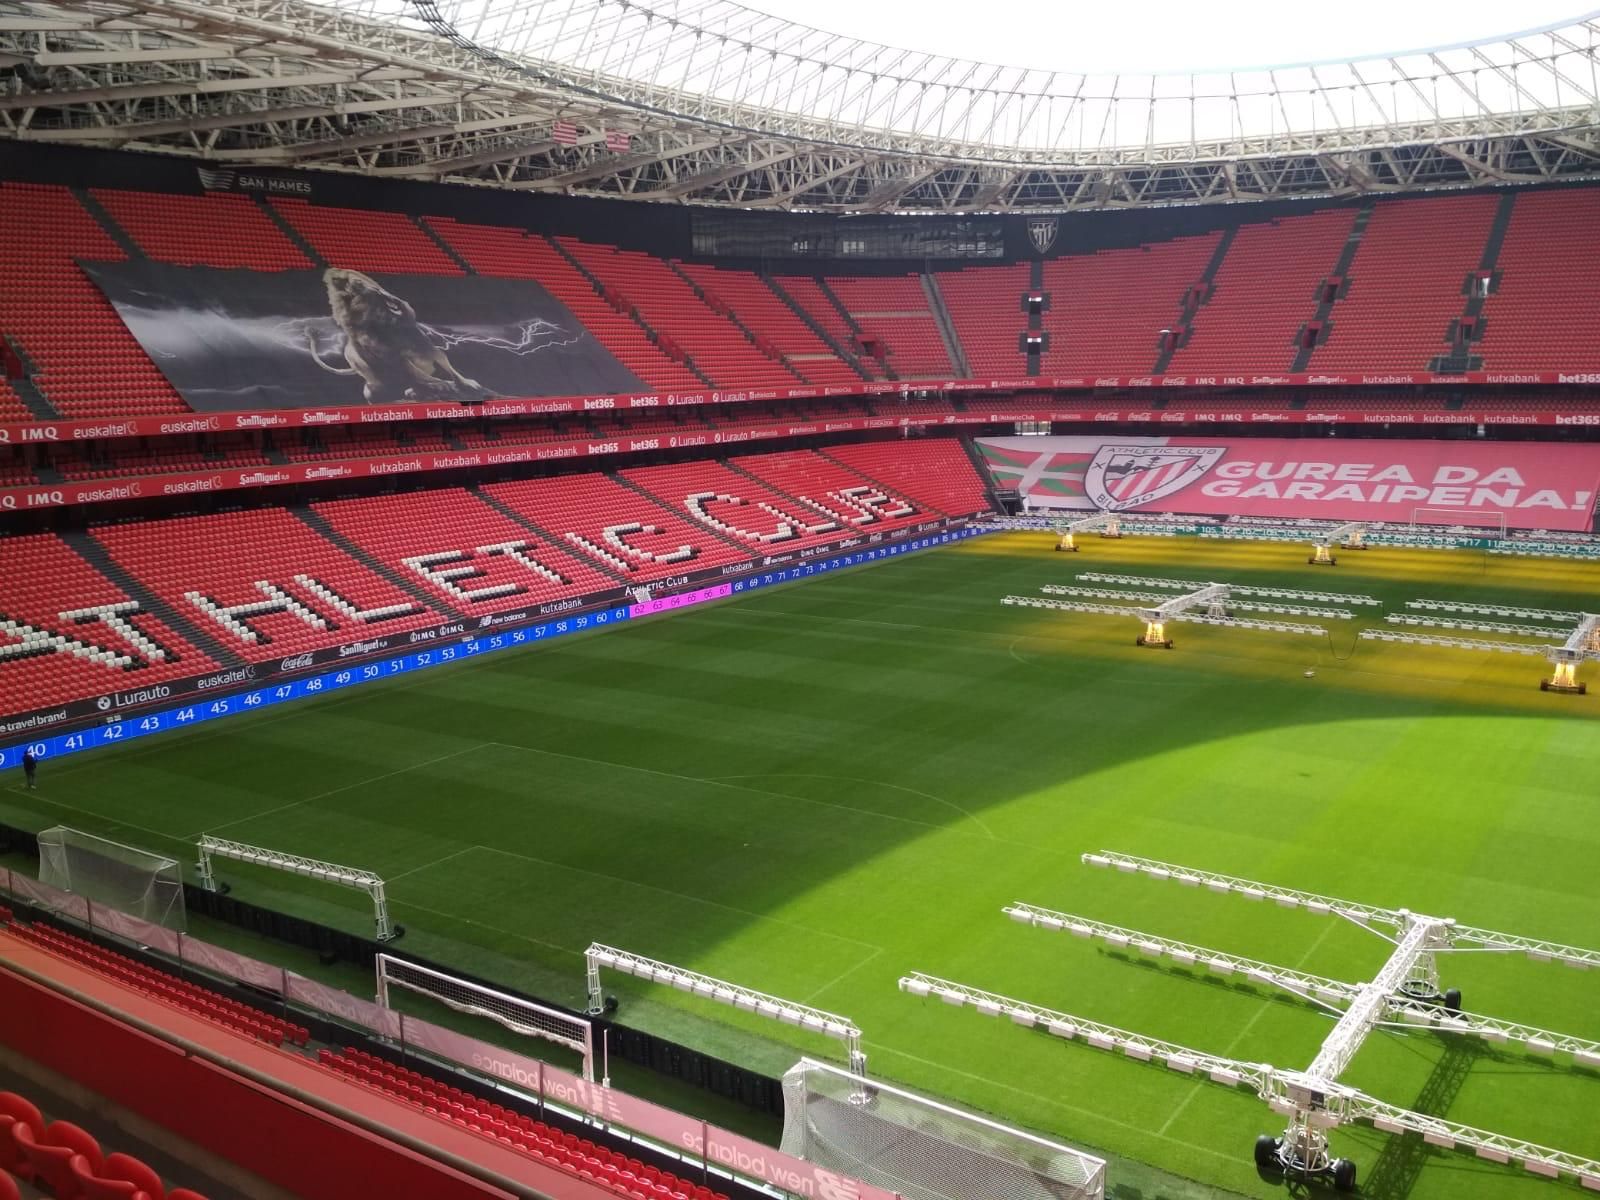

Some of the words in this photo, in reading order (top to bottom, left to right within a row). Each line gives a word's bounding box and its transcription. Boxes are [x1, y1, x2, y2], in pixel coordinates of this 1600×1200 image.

[239, 176, 265, 188] SAN
[268, 179, 312, 193] MAMES
[1195, 377, 1216, 385] IMQ
[1223, 377, 1244, 385] IMQ
[1362, 375, 1413, 384] kutxabank
[1487, 374, 1540, 384] kutxabank
[1558, 373, 1600, 384] bet365
[630, 397, 659, 407] bet365
[676, 394, 704, 405] Lurauto
[721, 391, 746, 402] Lurauto
[482, 403, 527, 416] kutxabank
[531, 401, 572, 413] kutxabank
[584, 399, 614, 410] bet365
[361, 409, 413, 422] kutxabank
[427, 407, 475, 419] kutxabank
[1194, 413, 1216, 422] IMQ
[1221, 413, 1242, 422] IMQ
[1364, 414, 1415, 423] kutxabank
[1423, 414, 1475, 423] kutxabank
[1484, 414, 1538, 424] kutxabank
[161, 419, 209, 433] euskaltel
[1556, 415, 1600, 425] bet365
[21, 426, 59, 441] IMQ
[73, 423, 127, 439] euskaltel
[722, 432, 748, 442] Lurauto
[631, 439, 659, 450] bet365
[678, 436, 705, 447] Lurauto
[537, 447, 578, 459] kutxabank
[588, 443, 618, 454] bet365
[1106, 447, 1172, 455] ATHLETIC
[1177, 448, 1217, 456] CLUB
[433, 454, 481, 468] kutxabank
[487, 451, 531, 464] kutxabank
[370, 459, 422, 474] kutxabank
[1215, 461, 1415, 484] GUREA
[1431, 465, 1526, 487] DA
[164, 479, 212, 494] euskaltel
[27, 491, 65, 505] IMQ
[77, 486, 130, 502] euskaltel
[1200, 480, 1591, 511] GARAIPENA!
[685, 486, 914, 542] CLUB
[722, 561, 754, 576] kutxabank
[666, 577, 689, 587] CLUB
[540, 598, 583, 615] kutxabank
[492, 618, 504, 626] new
[504, 613, 527, 623] balance
[446, 625, 465, 635] IMQ
[417, 631, 437, 642] IMQ
[27, 743, 46, 758] 40
[65, 735, 84, 750] 41
[104, 725, 123, 740] 42
[140, 717, 160, 731] 43
[176, 708, 195, 722] 44
[211, 700, 228, 714] 45
[244, 692, 262, 706] 46
[275, 685, 292, 699] 47
[306, 678, 322, 692] 48
[335, 671, 351, 685] 49
[363, 665, 379, 679] 50
[391, 660, 404, 672] 51
[417, 654, 431, 666] 52
[442, 648, 455, 660] 53
[467, 642, 480, 654] 54
[490, 637, 502, 648] 55
[513, 631, 525, 643] 56
[535, 627, 546, 638] 57
[556, 622, 568, 633] 58
[576, 617, 588, 628] 59
[596, 613, 608, 623] 60
[615, 609, 626, 619] 61
[634, 605, 645, 614] 62
[653, 601, 663, 610] 63
[671, 597, 681, 607] 64
[687, 593, 697, 602] 65
[703, 590, 713, 599] 66
[719, 586, 729, 596] 67
[735, 582, 744, 592] 68
[749, 578, 758, 588] 69
[764, 575, 773, 585] 70
[778, 572, 787, 581] 71
[792, 568, 800, 578] 72
[805, 566, 814, 575] 73
[819, 562, 828, 572] 74
[832, 559, 840, 568] 75
[844, 556, 853, 565] 76
[856, 554, 864, 563] 77
[868, 551, 876, 560] 78
[879, 548, 887, 557] 79
[198, 668, 246, 689] euskaltel
[115, 685, 170, 707] Lurauto
[7, 715, 37, 731] travel
[37, 710, 67, 725] brand
